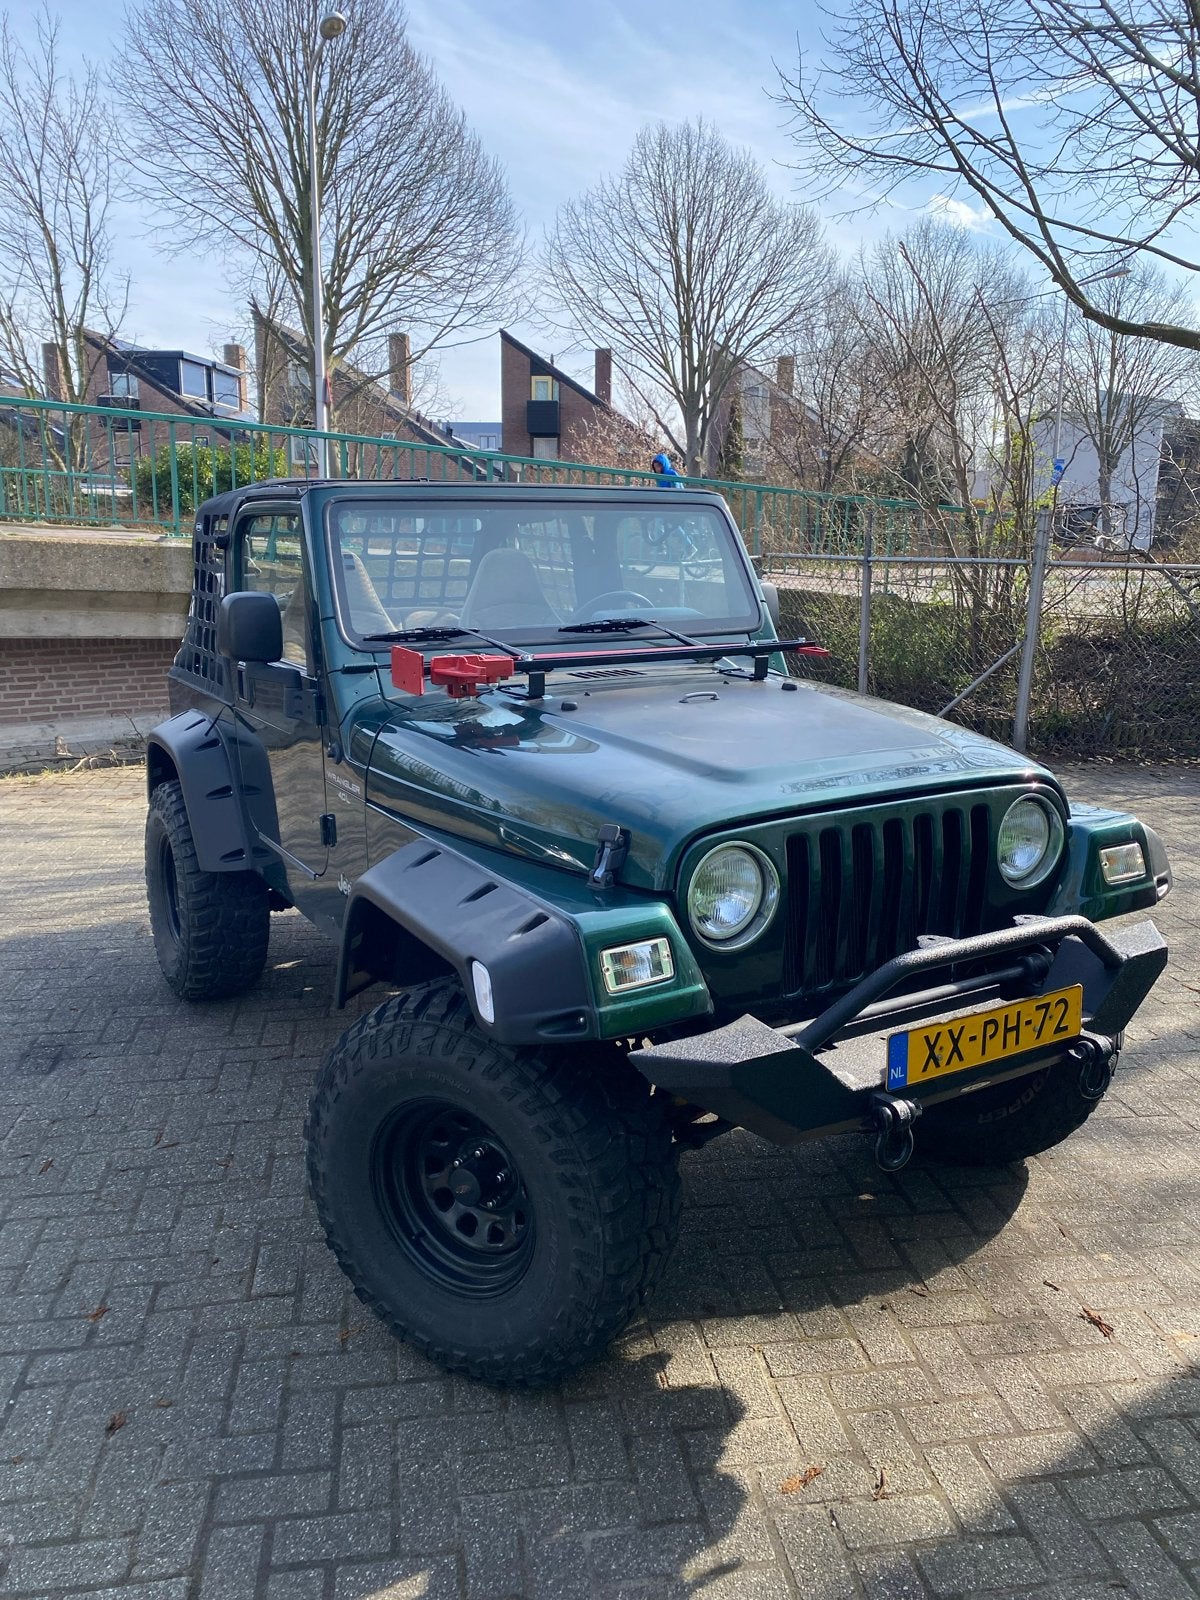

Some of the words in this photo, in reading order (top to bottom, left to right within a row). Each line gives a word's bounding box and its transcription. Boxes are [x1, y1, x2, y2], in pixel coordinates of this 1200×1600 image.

[326, 770, 360, 794] WRANGLER
[338, 873, 352, 895] Jee
[921, 997, 1069, 1073] XX-PH-72
[890, 1067, 905, 1080] NL
